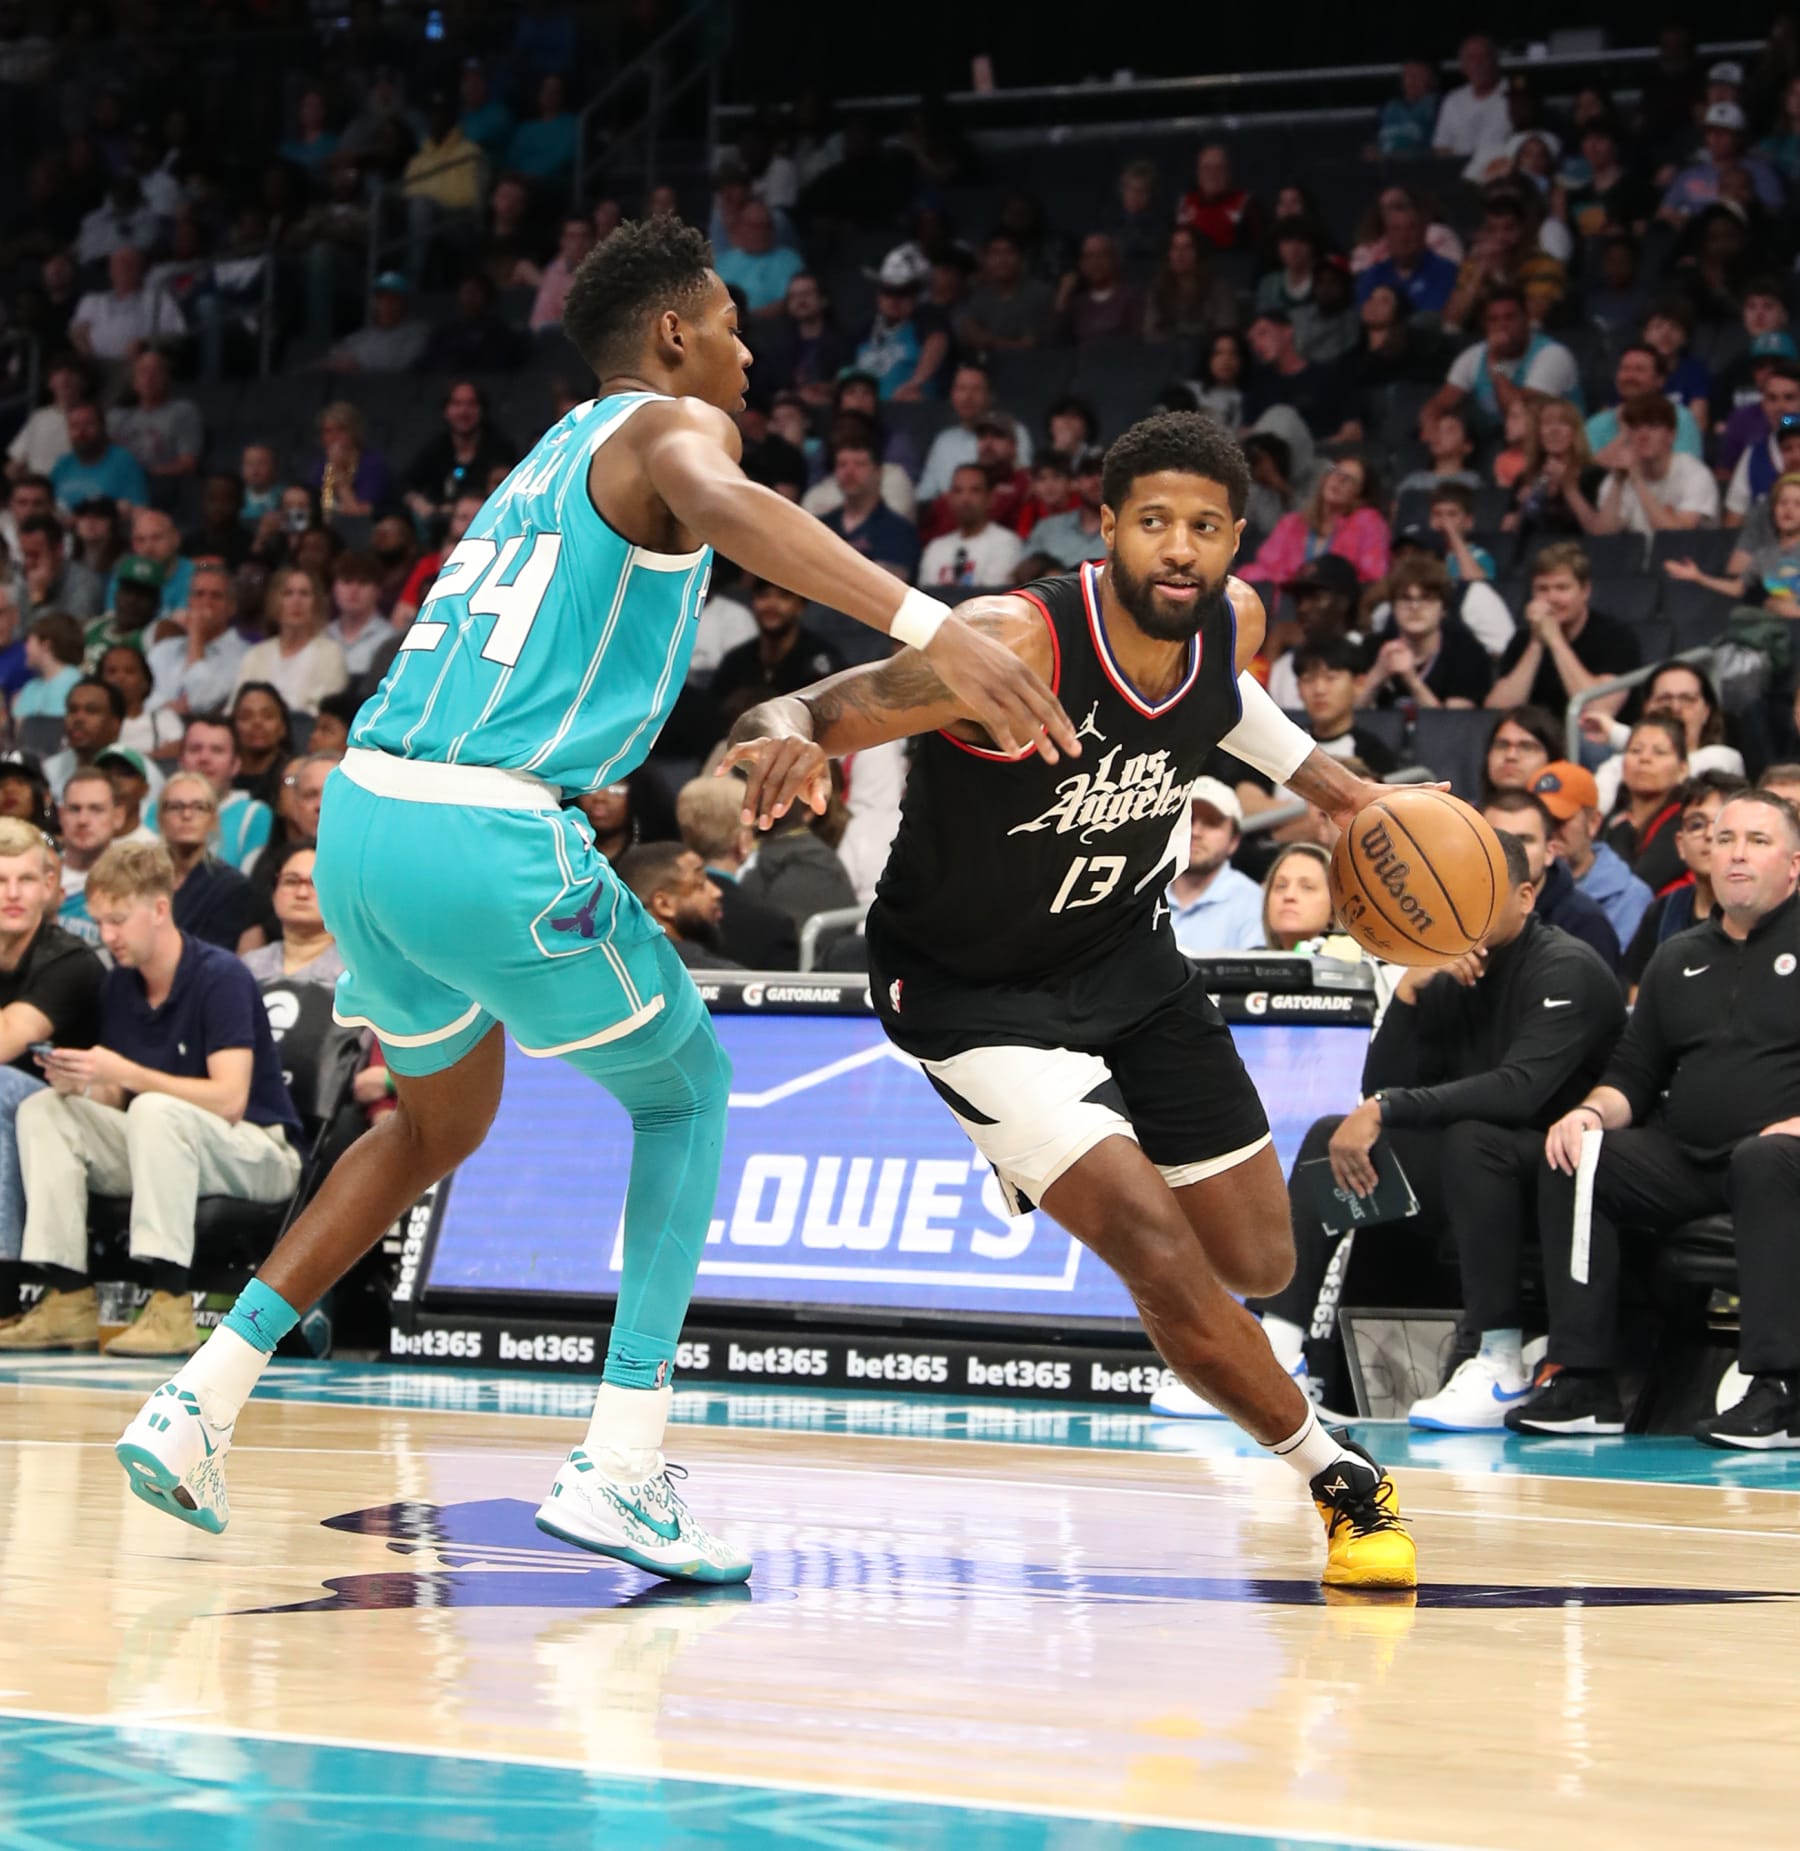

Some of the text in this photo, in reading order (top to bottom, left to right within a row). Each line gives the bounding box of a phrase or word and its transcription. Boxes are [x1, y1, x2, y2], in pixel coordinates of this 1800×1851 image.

[399, 533, 562, 668] 24
[1007, 767, 1194, 844] Angeles
[1086, 744, 1171, 795] Los
[1050, 856, 1127, 913] 13
[1361, 820, 1434, 935] Wilson
[766, 986, 842, 1003] GATORADE
[1271, 994, 1353, 1011] GATORADE
[706, 1149, 1036, 1260] OWE'S
[392, 1205, 431, 1300] bet365
[389, 1327, 482, 1358] bet365
[498, 1332, 595, 1363] bet365
[727, 1343, 828, 1376] bet365
[846, 1349, 948, 1383] bet365
[967, 1356, 1071, 1390] bet365
[1090, 1362, 1178, 1394] bet36
